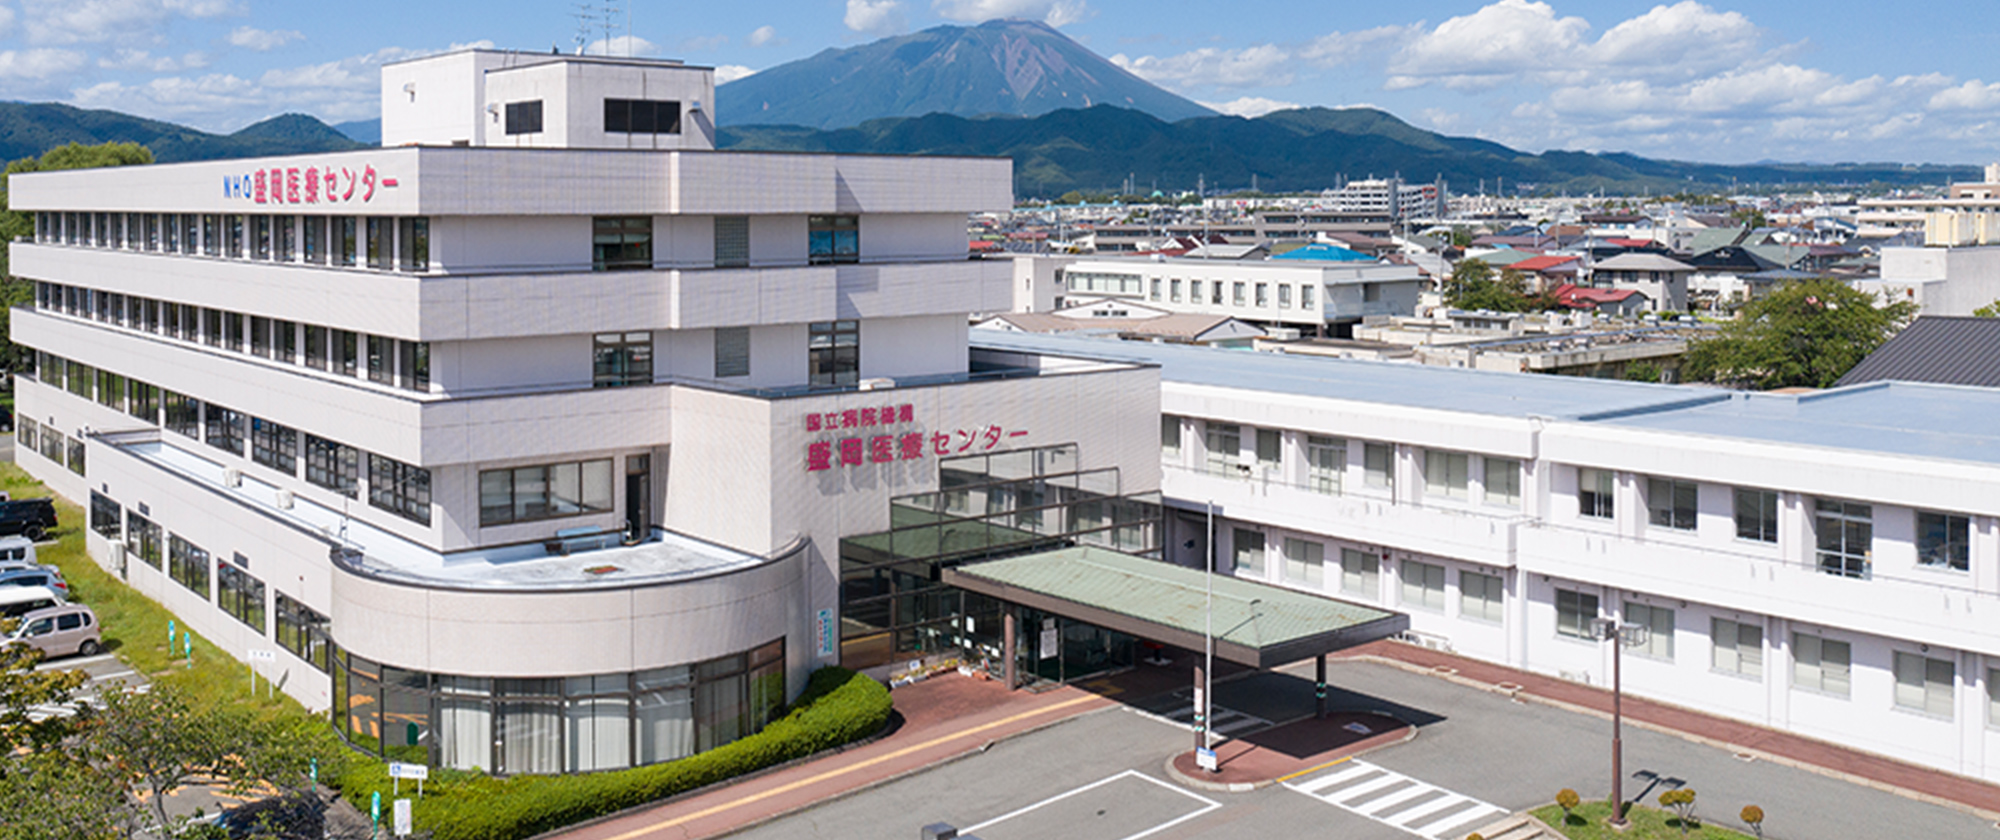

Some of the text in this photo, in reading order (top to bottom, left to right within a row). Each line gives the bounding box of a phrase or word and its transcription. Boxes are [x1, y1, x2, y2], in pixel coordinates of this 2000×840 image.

[223, 164, 398, 203] NHO 盛岡医療センター
[806, 404, 914, 432] 国立病院機構
[807, 425, 1029, 471] 盛岡医療センター
